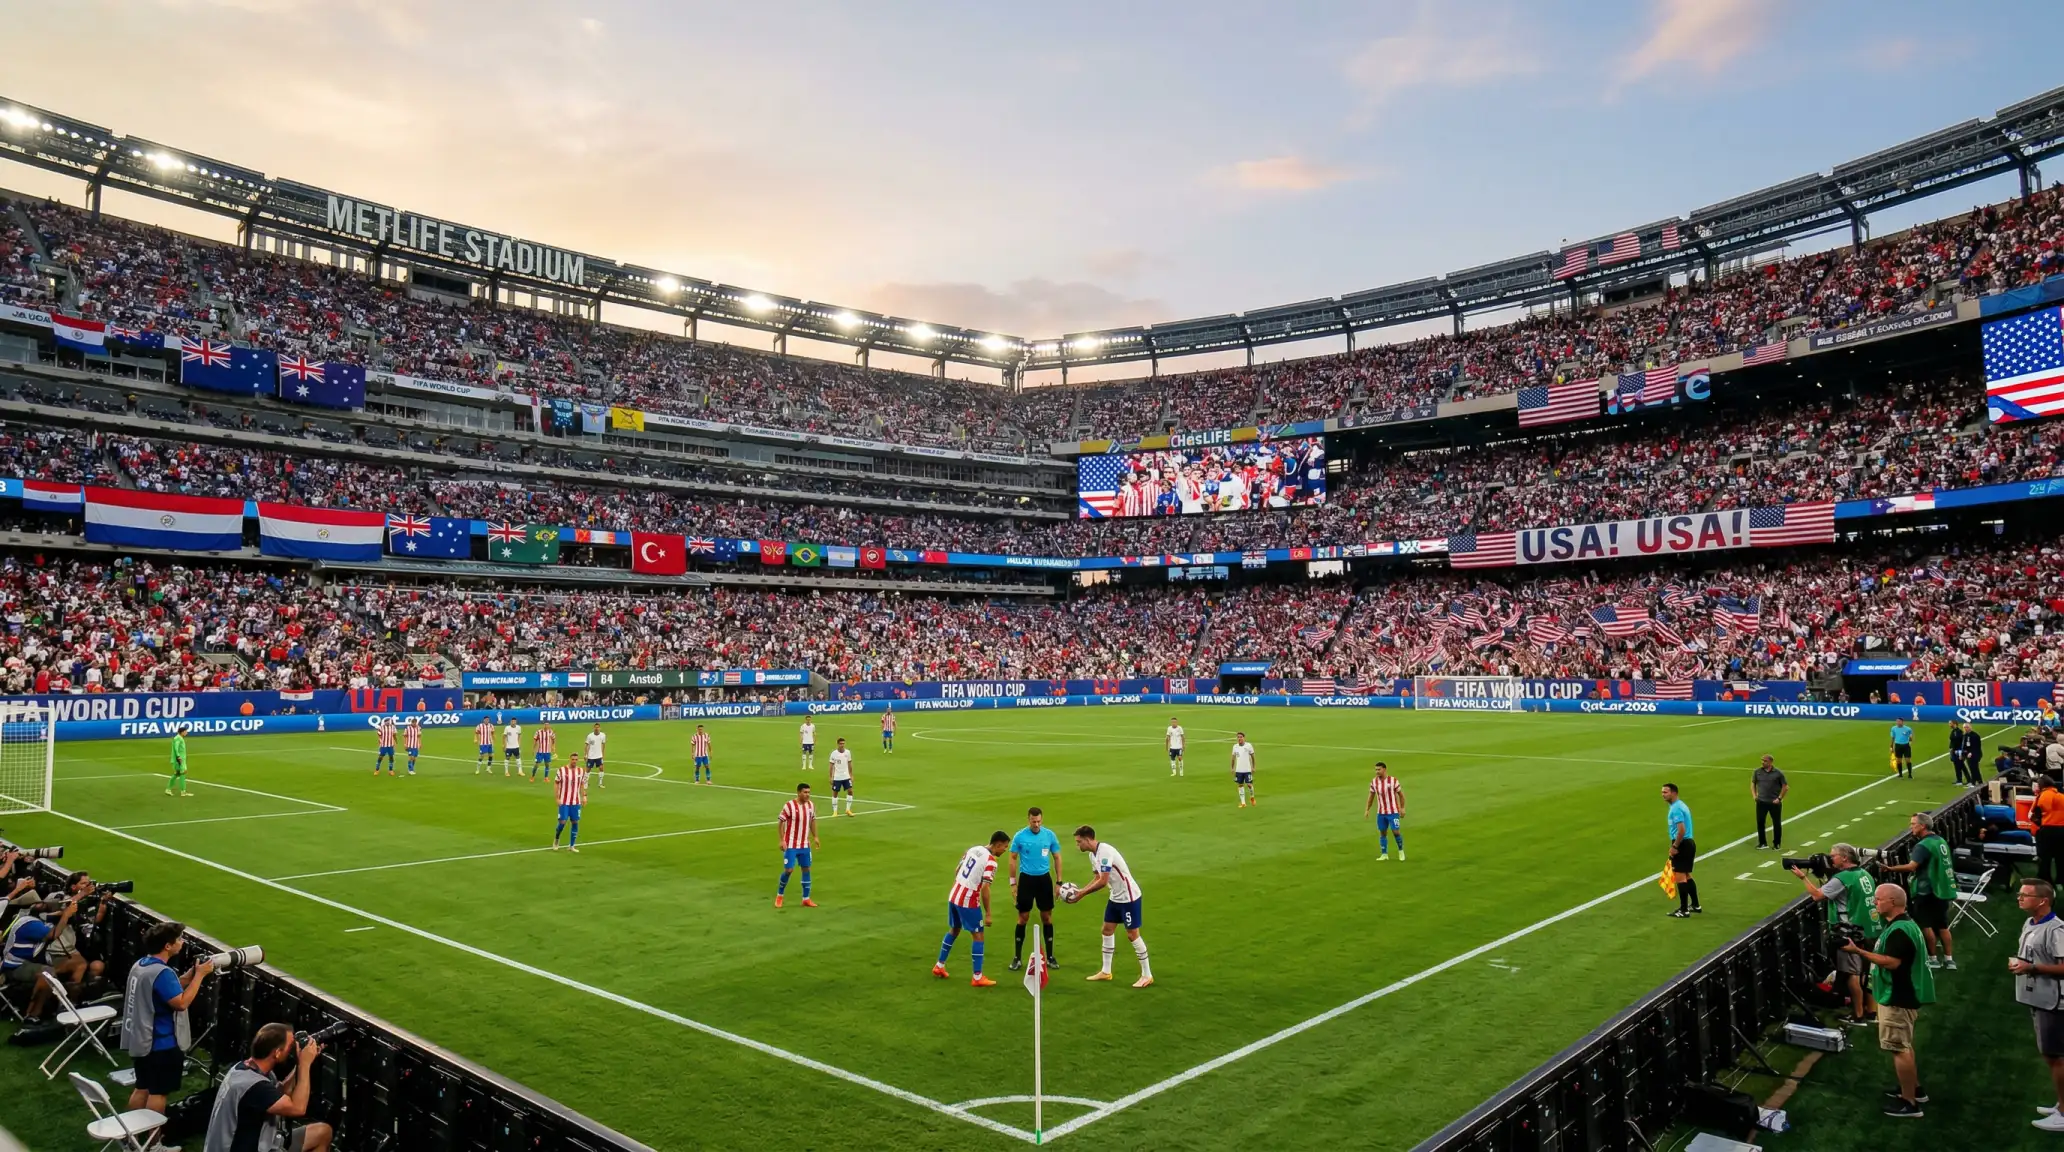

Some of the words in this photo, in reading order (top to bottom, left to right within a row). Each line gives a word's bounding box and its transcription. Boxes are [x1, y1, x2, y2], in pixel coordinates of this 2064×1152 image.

[327, 195, 454, 257] METLIFE
[465, 231, 584, 286] STADIUM
[1523, 523, 1619, 561] USA!
[1637, 511, 1743, 553] USA!
[942, 683, 965, 698] FIFA
[967, 683, 1003, 697] WORLD
[1005, 683, 1026, 697] CUP
[1455, 683, 1487, 699] FIFA
[1490, 683, 1546, 699] WORLD
[1551, 683, 1583, 700] CUP
[1957, 682, 1986, 699] USA
[1214, 696, 1242, 704] WORLD
[1243, 696, 1259, 705] CUP
[1429, 698, 1450, 708] FIFA
[1452, 699, 1489, 709] WORLD
[1491, 700, 1511, 709] CUP
[48, 698, 139, 721] WORLD
[145, 697, 194, 718] CUP
[539, 710, 566, 721] FIFA
[568, 709, 610, 720] WORLD
[612, 708, 634, 719] CUP
[683, 707, 706, 717] FIFA
[706, 706, 743, 716] WORLD
[744, 705, 761, 715] CUP
[1745, 704, 1773, 714] FIFA
[1776, 705, 1828, 716] WORLD
[1831, 705, 1860, 717] CUP
[120, 722, 159, 735] FIFA
[163, 720, 227, 733] WORLD
[230, 719, 264, 731] CUP
[1125, 911, 1132, 922] 5
